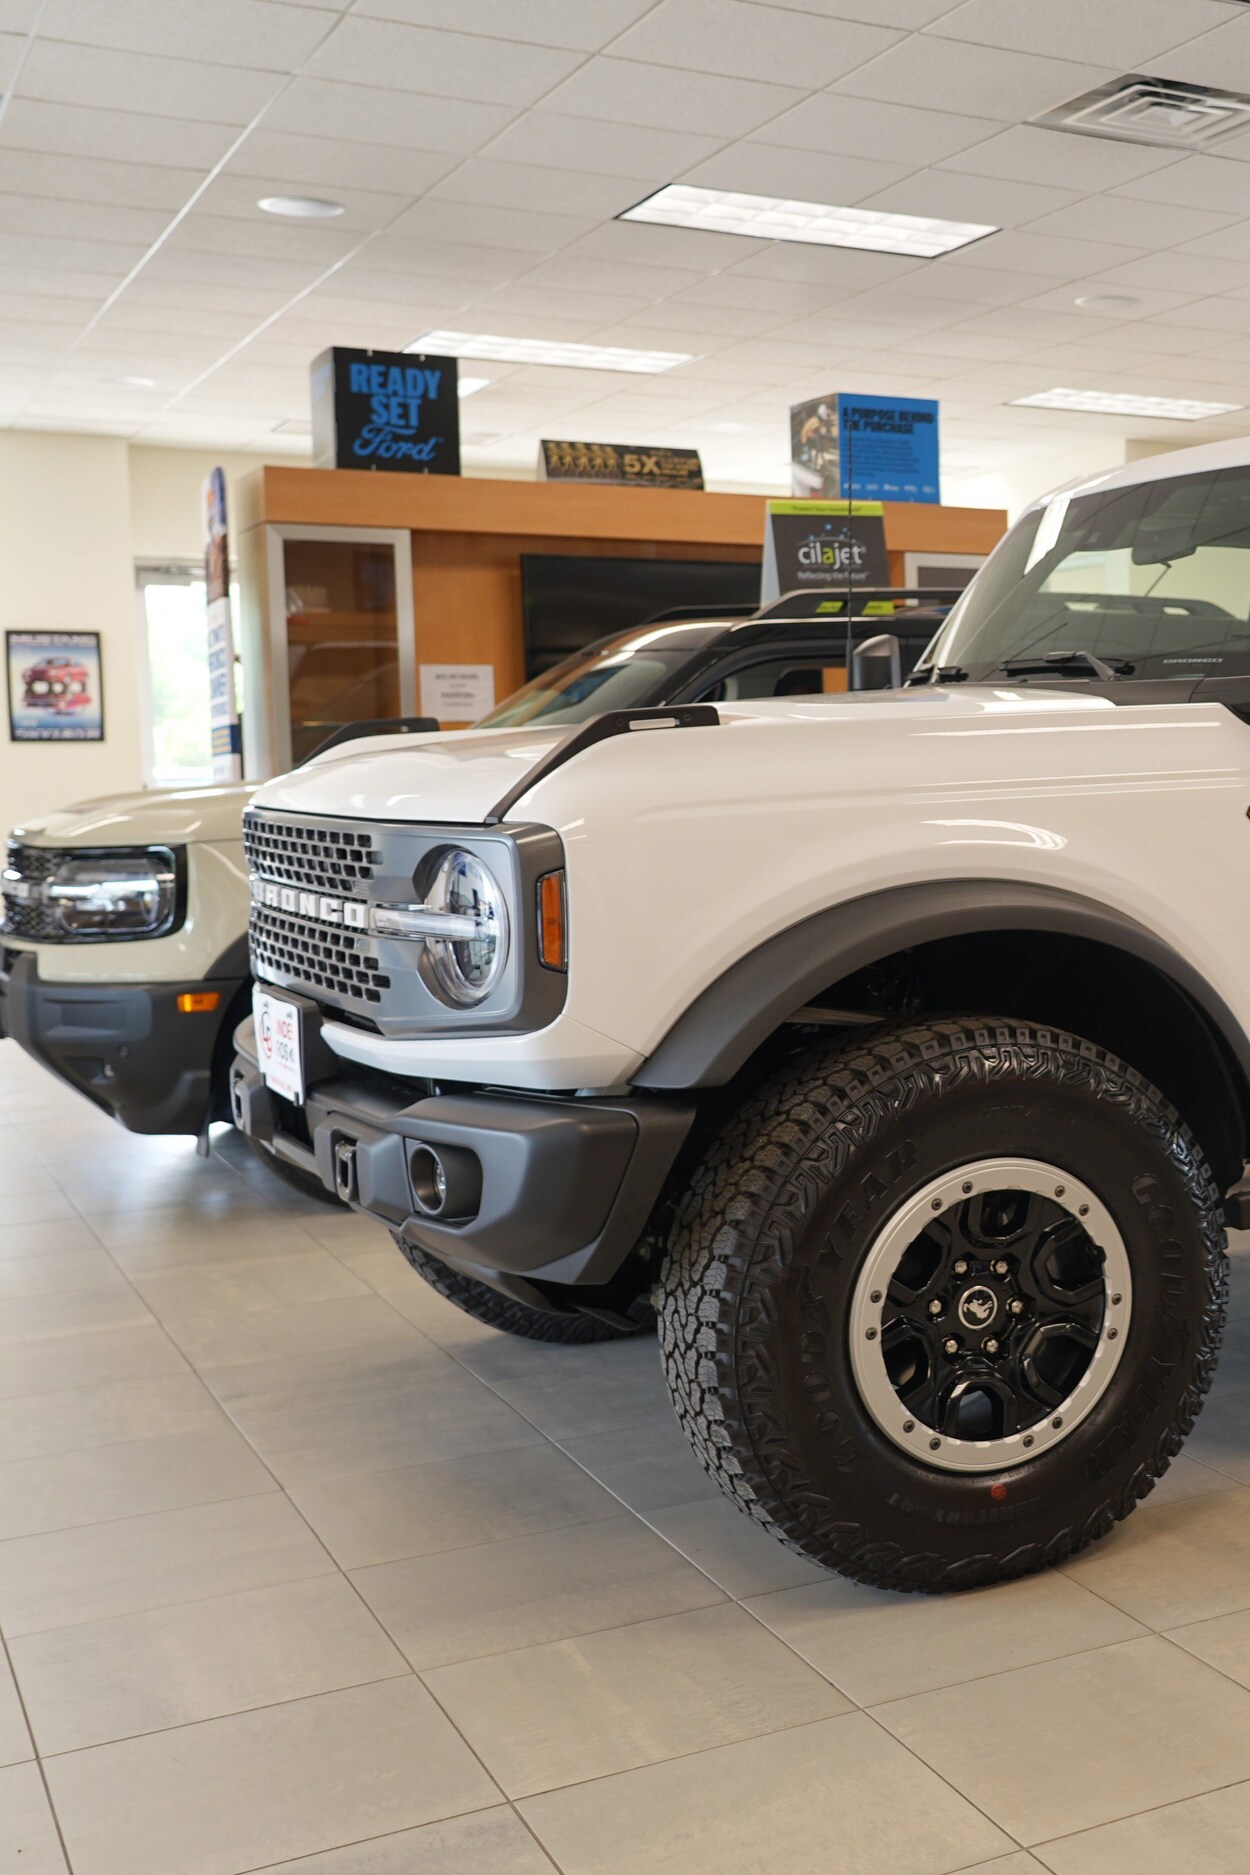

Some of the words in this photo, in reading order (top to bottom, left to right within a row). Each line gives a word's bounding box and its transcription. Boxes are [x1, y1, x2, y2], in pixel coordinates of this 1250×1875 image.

[350, 363, 441, 399] READY
[370, 394, 422, 427] SET
[353, 423, 437, 461] Ford
[622, 453, 661, 476] 5X
[797, 541, 862, 570] cilajet
[253, 879, 366, 928] BRONCO
